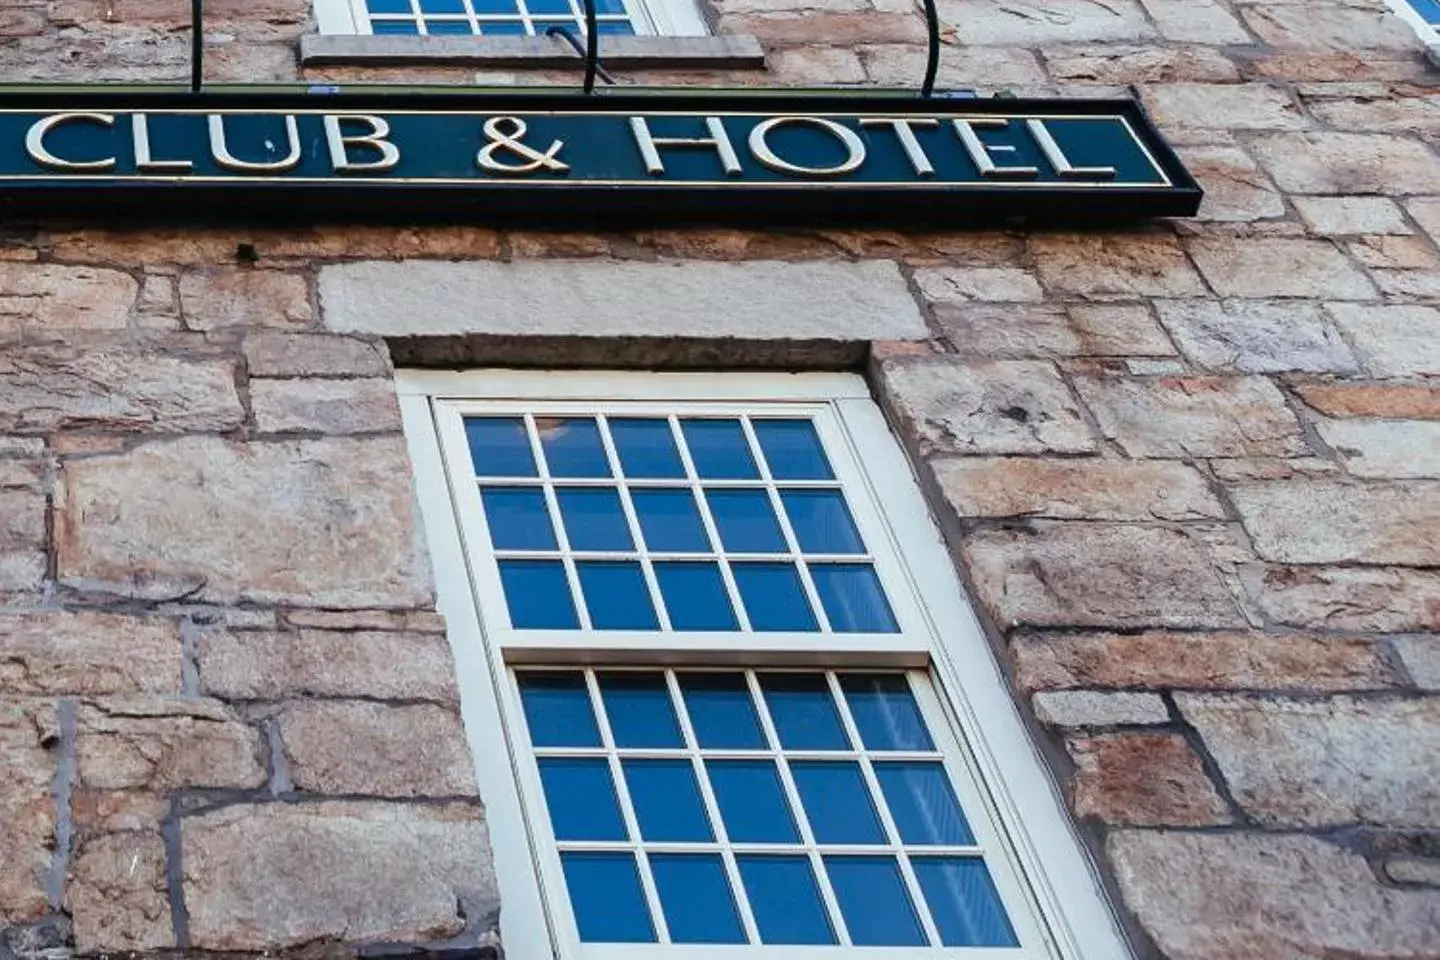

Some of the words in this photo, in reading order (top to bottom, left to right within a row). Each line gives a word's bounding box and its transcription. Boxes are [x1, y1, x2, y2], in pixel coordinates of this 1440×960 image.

[24, 112, 400, 173] CLUB
[476, 115, 570, 174] &
[629, 116, 1116, 178] HOTEL
